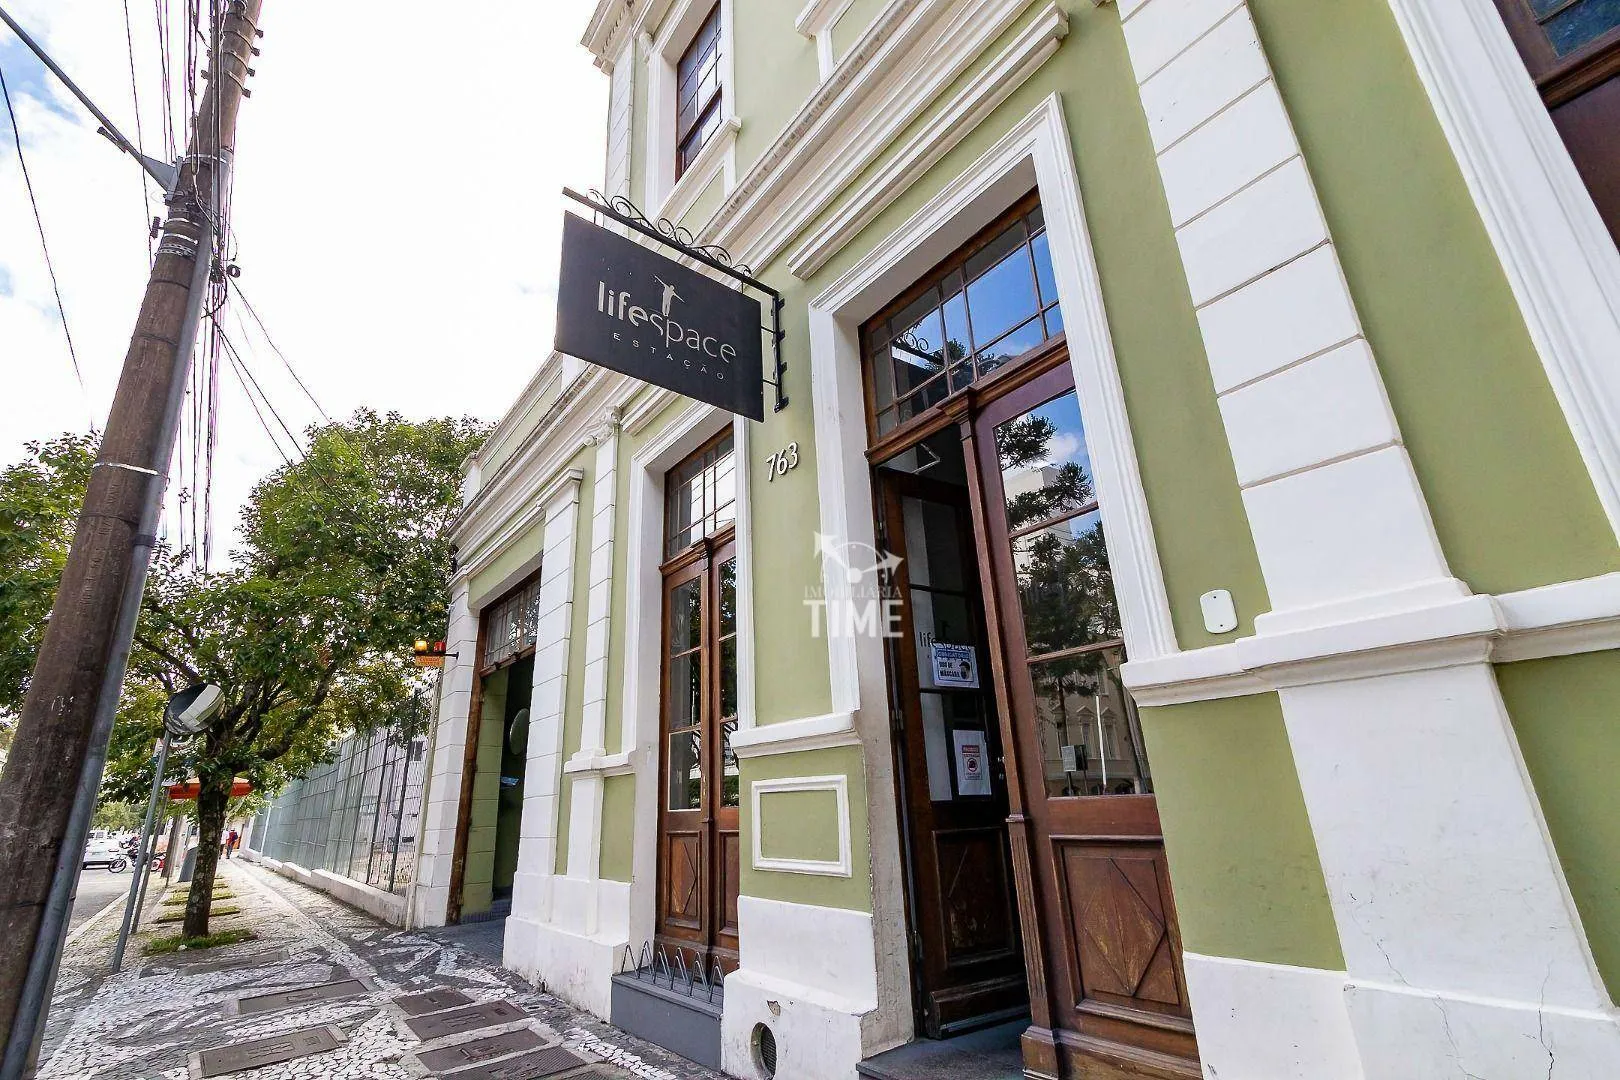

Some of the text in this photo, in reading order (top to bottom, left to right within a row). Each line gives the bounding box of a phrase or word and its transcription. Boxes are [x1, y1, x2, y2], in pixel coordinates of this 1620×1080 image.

[597, 280, 737, 364] lifespace
[612, 331, 724, 381] ESTAÇÃO
[765, 441, 799, 482] 763
